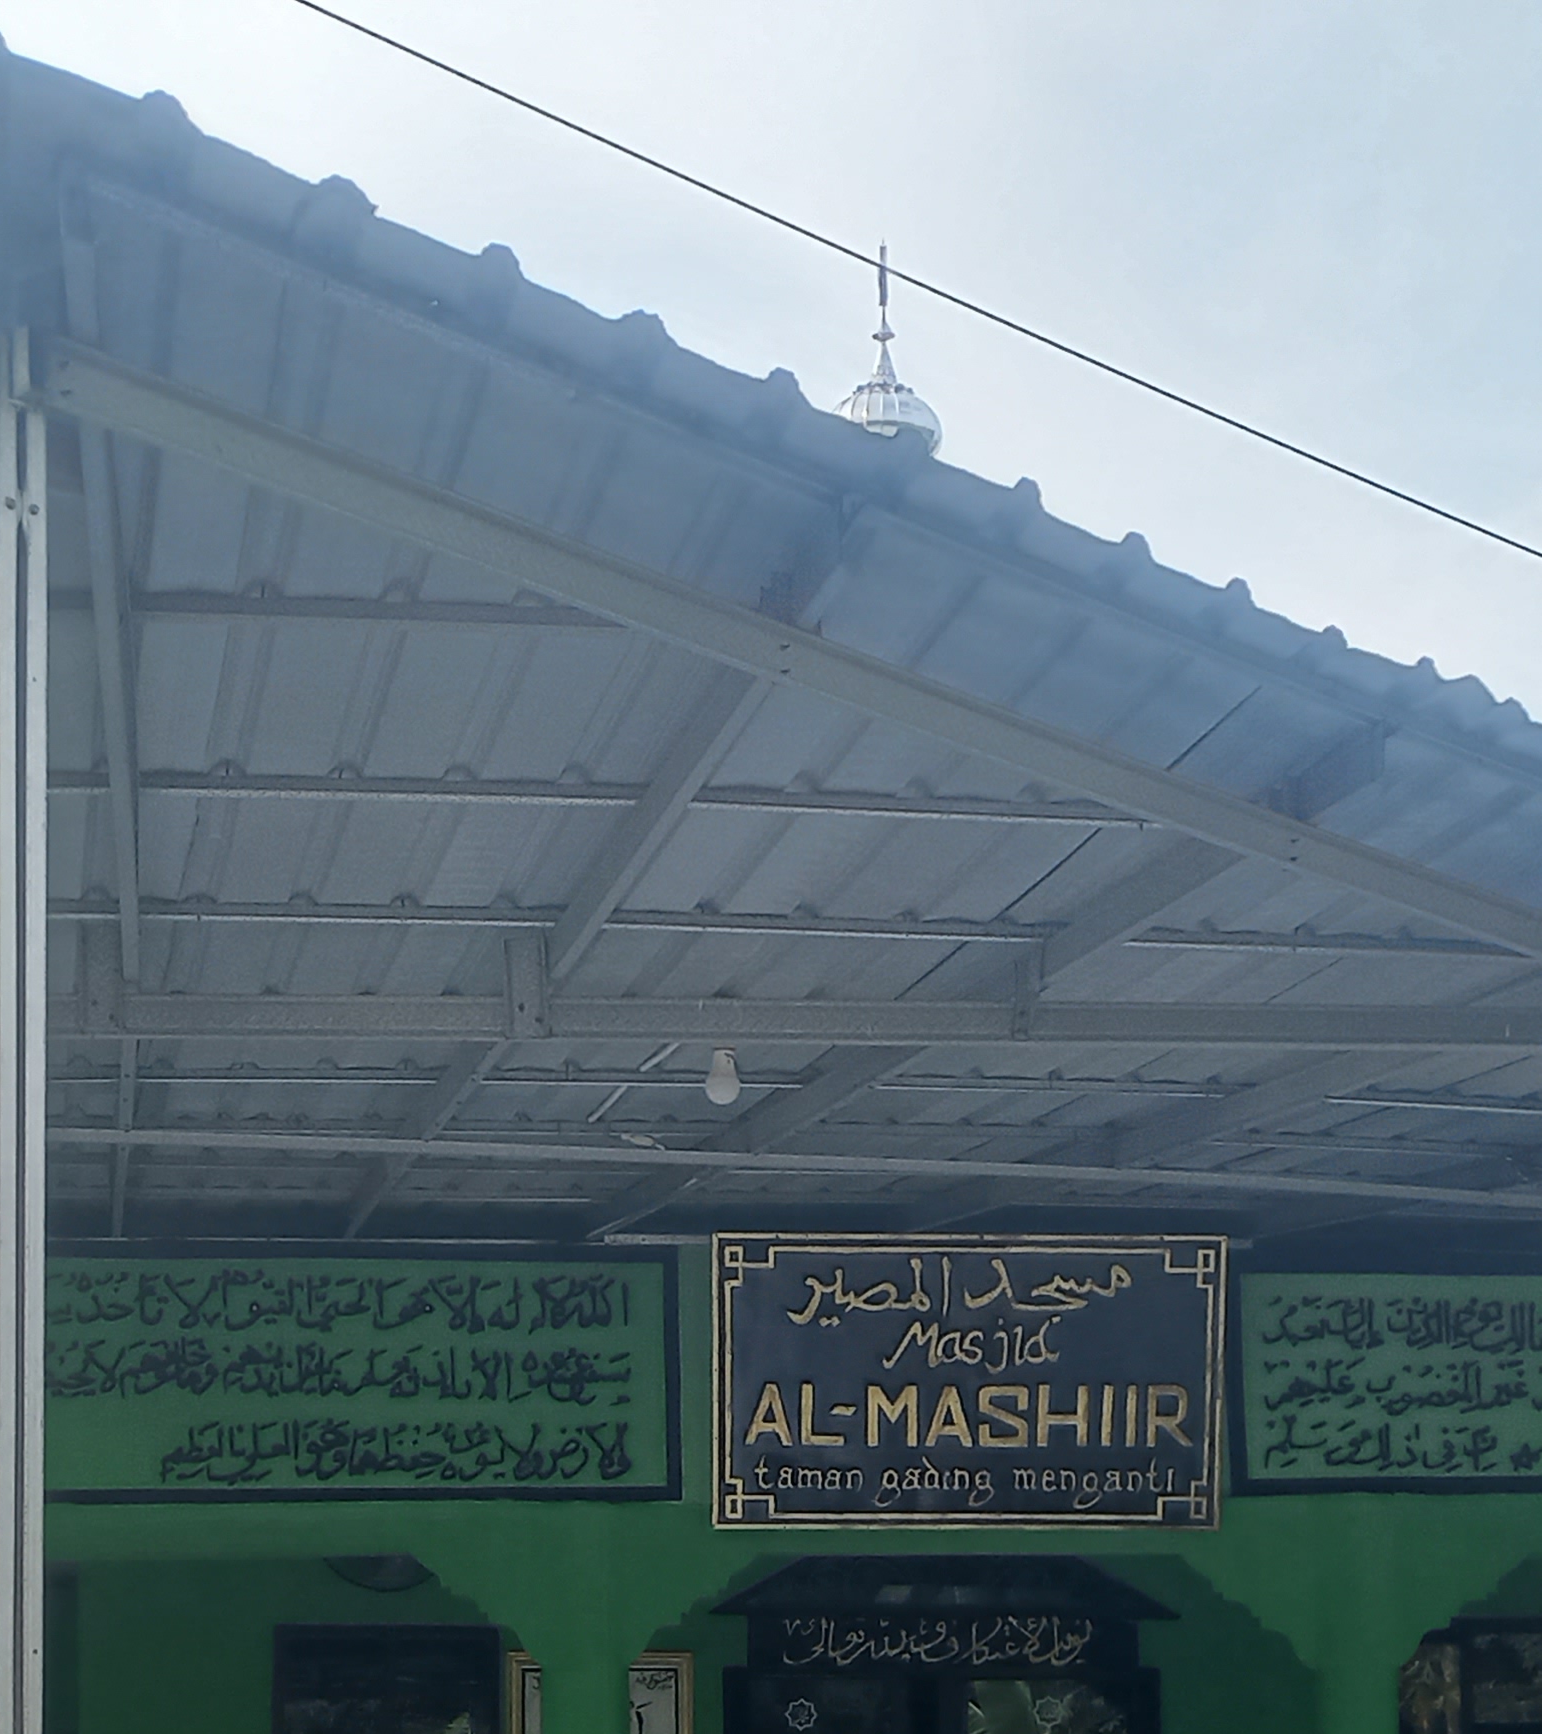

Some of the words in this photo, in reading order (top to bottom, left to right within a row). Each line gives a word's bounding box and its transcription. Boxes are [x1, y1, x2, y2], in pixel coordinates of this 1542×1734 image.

[881, 1315, 1064, 1374] Masjid
[745, 1382, 1194, 1448] AL-MASHIIR
[754, 1456, 864, 1492] taman
[1013, 1458, 1176, 1510] menganti
